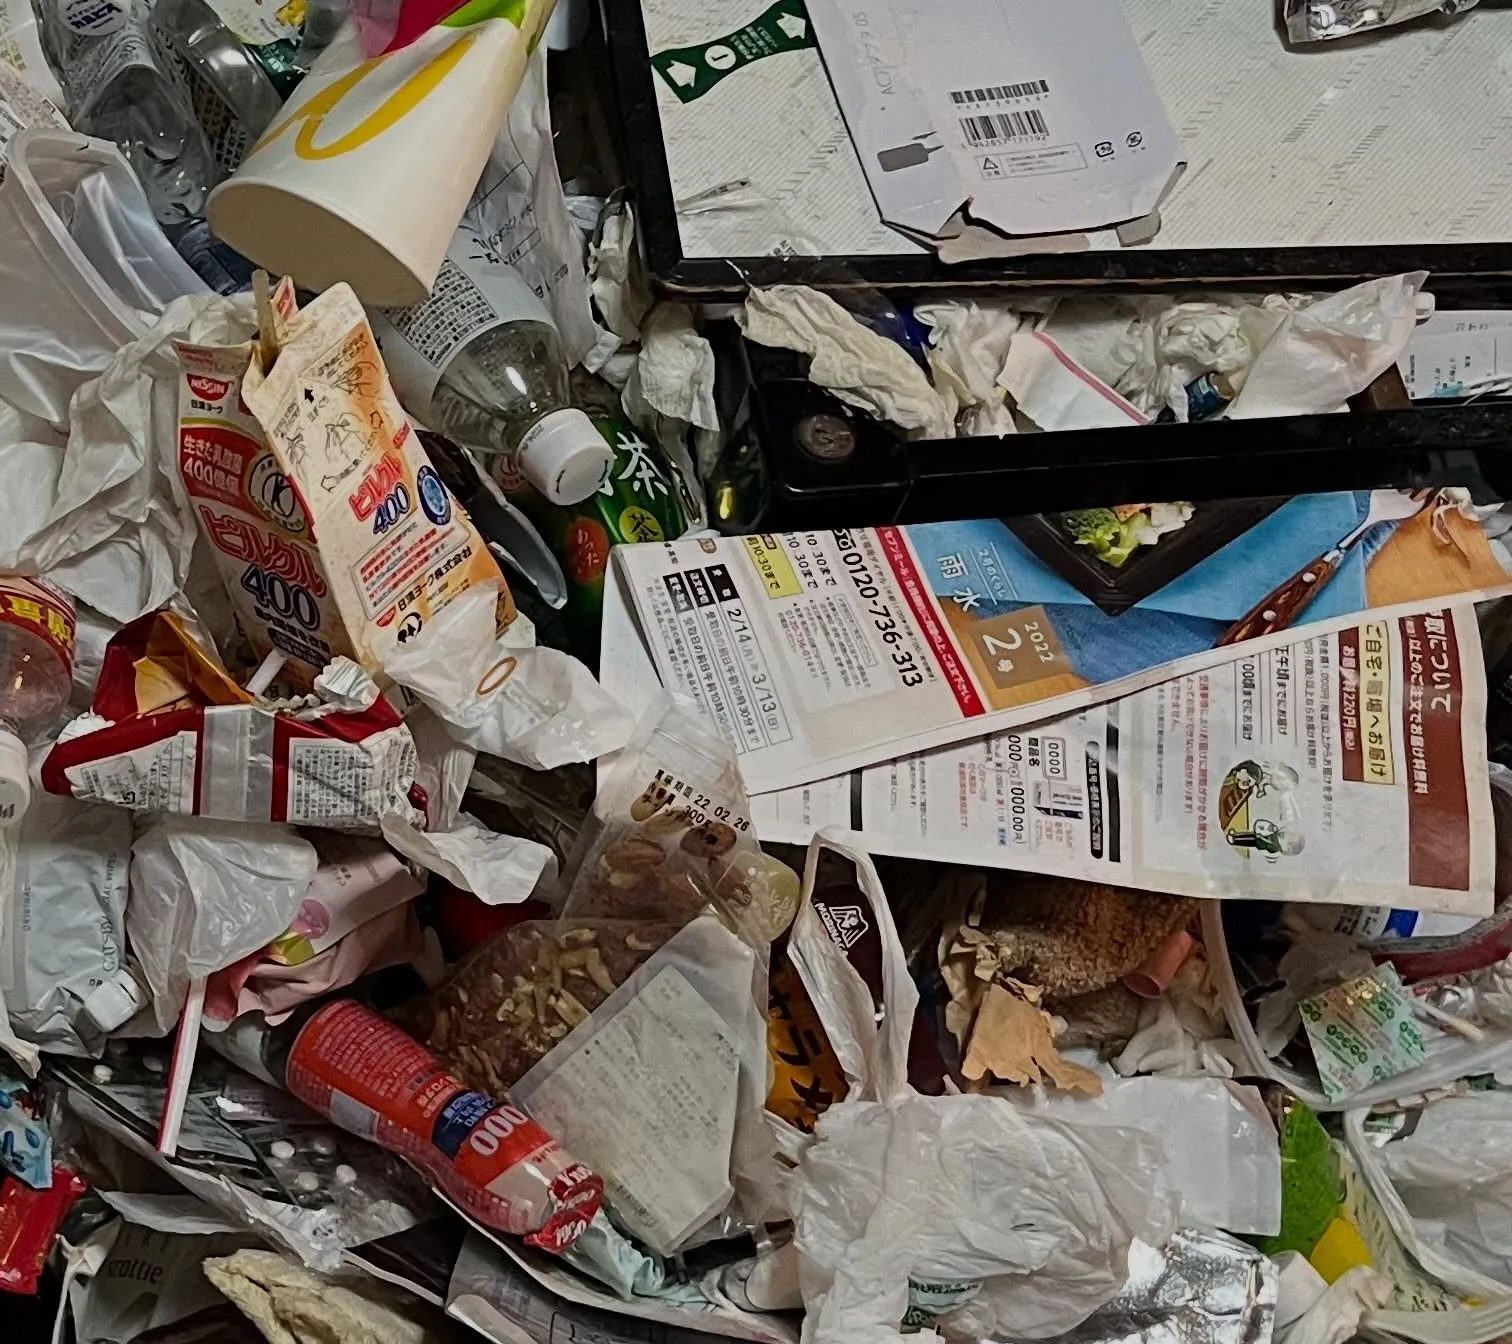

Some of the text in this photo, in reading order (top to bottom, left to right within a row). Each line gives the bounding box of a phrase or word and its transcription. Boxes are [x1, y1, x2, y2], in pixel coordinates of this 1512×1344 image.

[348, 455, 405, 523] ピルクル
[372, 483, 412, 536] 400
[198, 503, 328, 605] ピルクル
[395, 544, 473, 611] 日清ヨーク株式会社
[239, 562, 322, 631] 400
[841, 550, 924, 689] 0120-736-313
[1023, 621, 1054, 664] 2022
[1364, 622, 1388, 778] ご自宅・職場へお届け
[1023, 735, 1042, 768] 商品名
[1043, 740, 1063, 776] 0000
[692, 792, 712, 811] 22
[712, 803, 732, 823] 02
[732, 814, 751, 832] 26
